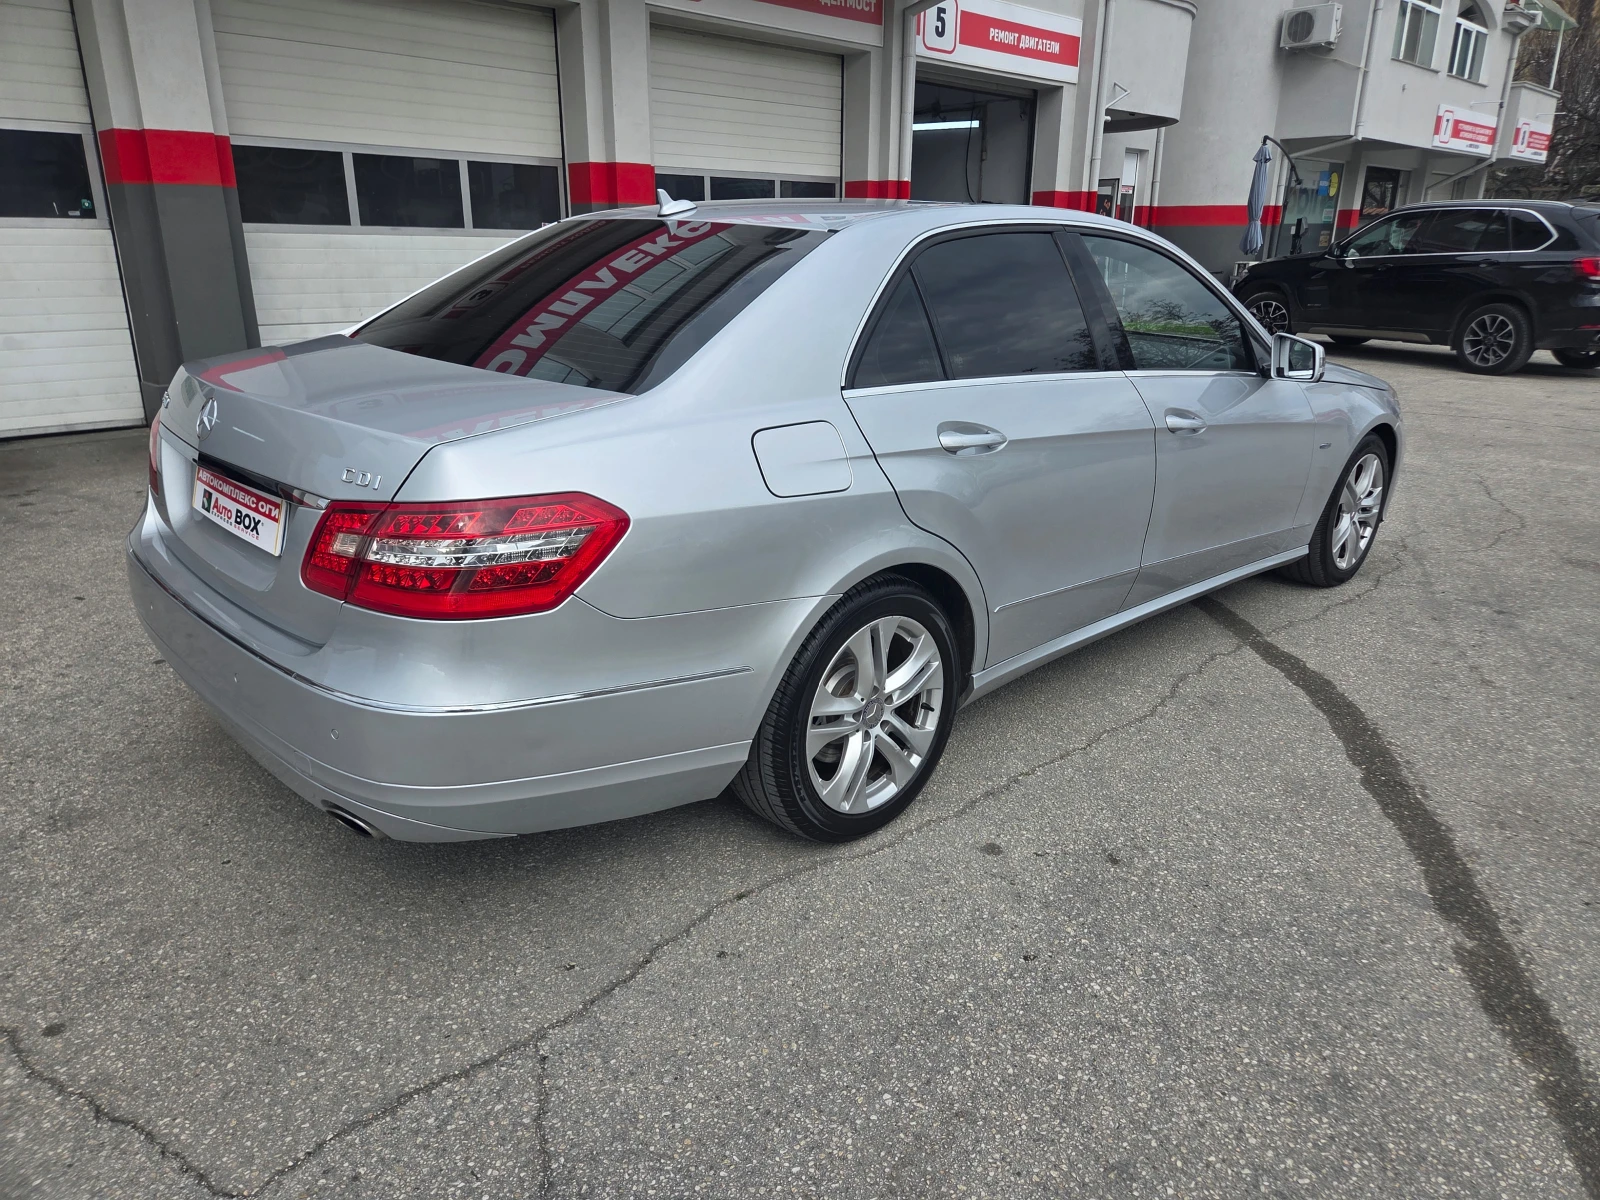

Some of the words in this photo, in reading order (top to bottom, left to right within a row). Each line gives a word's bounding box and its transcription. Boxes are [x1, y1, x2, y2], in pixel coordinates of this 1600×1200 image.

[846, 0, 877, 12] МОСТ
[935, 6, 947, 38] 5
[989, 27, 1018, 46] РЕМОНТ
[1019, 34, 1060, 55] ДВИГАТЕЛИ
[340, 467, 382, 490] CDI
[199, 469, 257, 510] АВТОКОМПЛЕКС
[258, 501, 280, 519] ОГИ
[211, 511, 233, 527] EXPRESS
[234, 524, 260, 541] SERVICE
